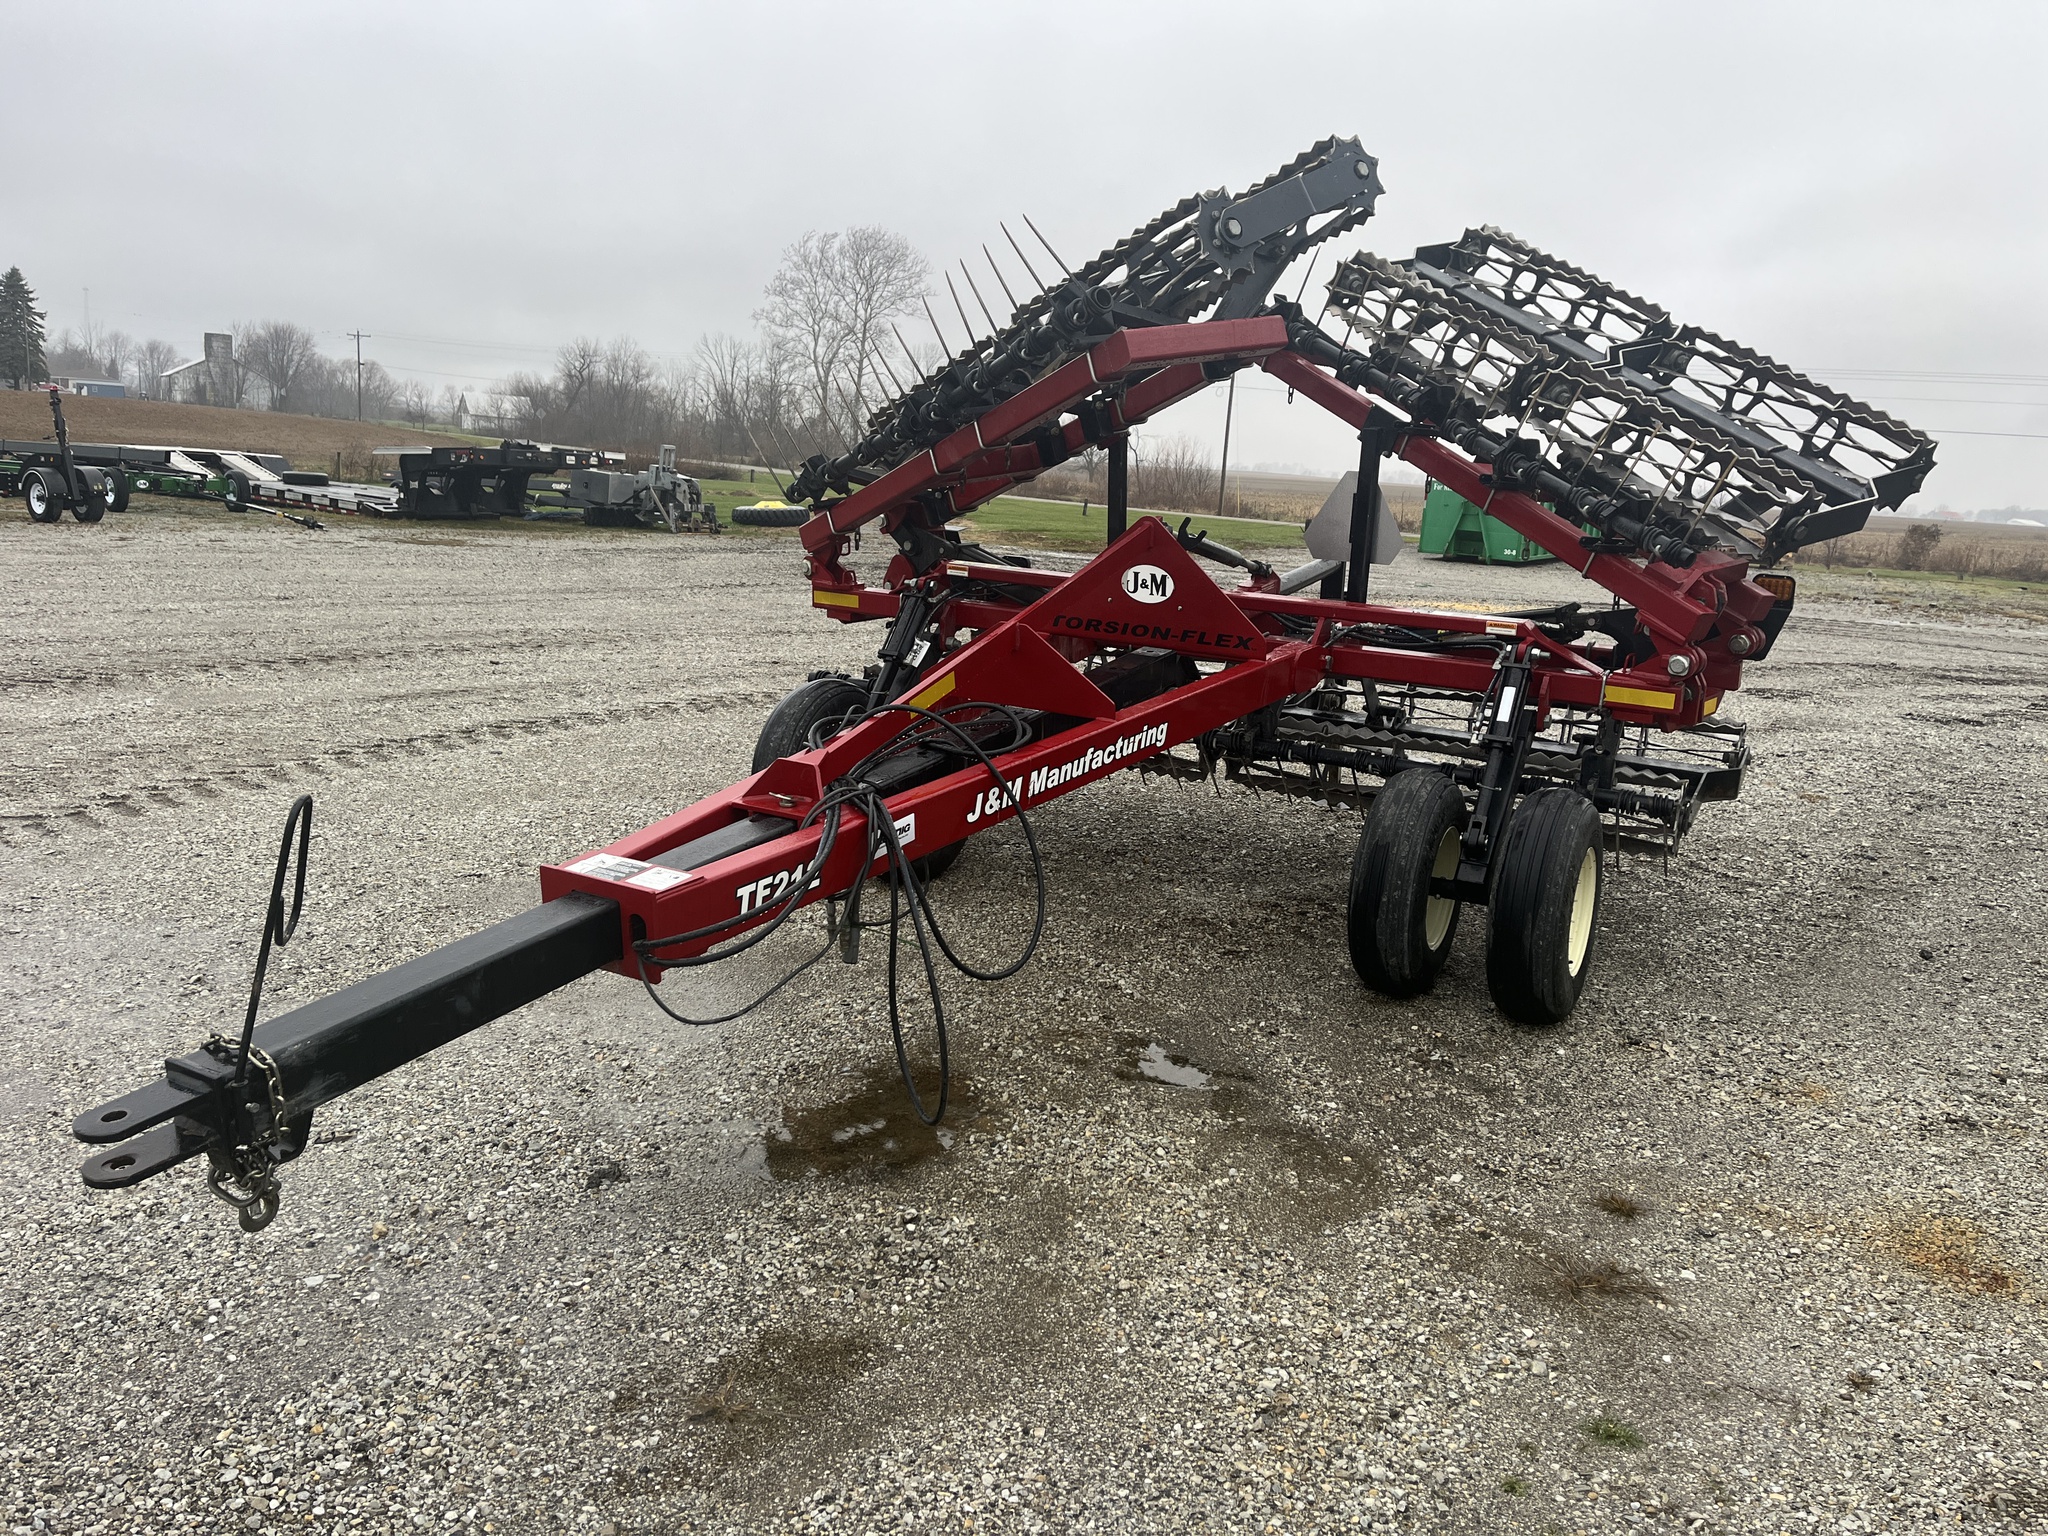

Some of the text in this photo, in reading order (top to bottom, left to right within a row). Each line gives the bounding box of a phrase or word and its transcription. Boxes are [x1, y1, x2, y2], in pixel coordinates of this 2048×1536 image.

[1127, 571, 1167, 597] J&M
[1052, 615, 1256, 650] TORSION-FLEX
[967, 722, 1169, 824] J&M Manufacturing
